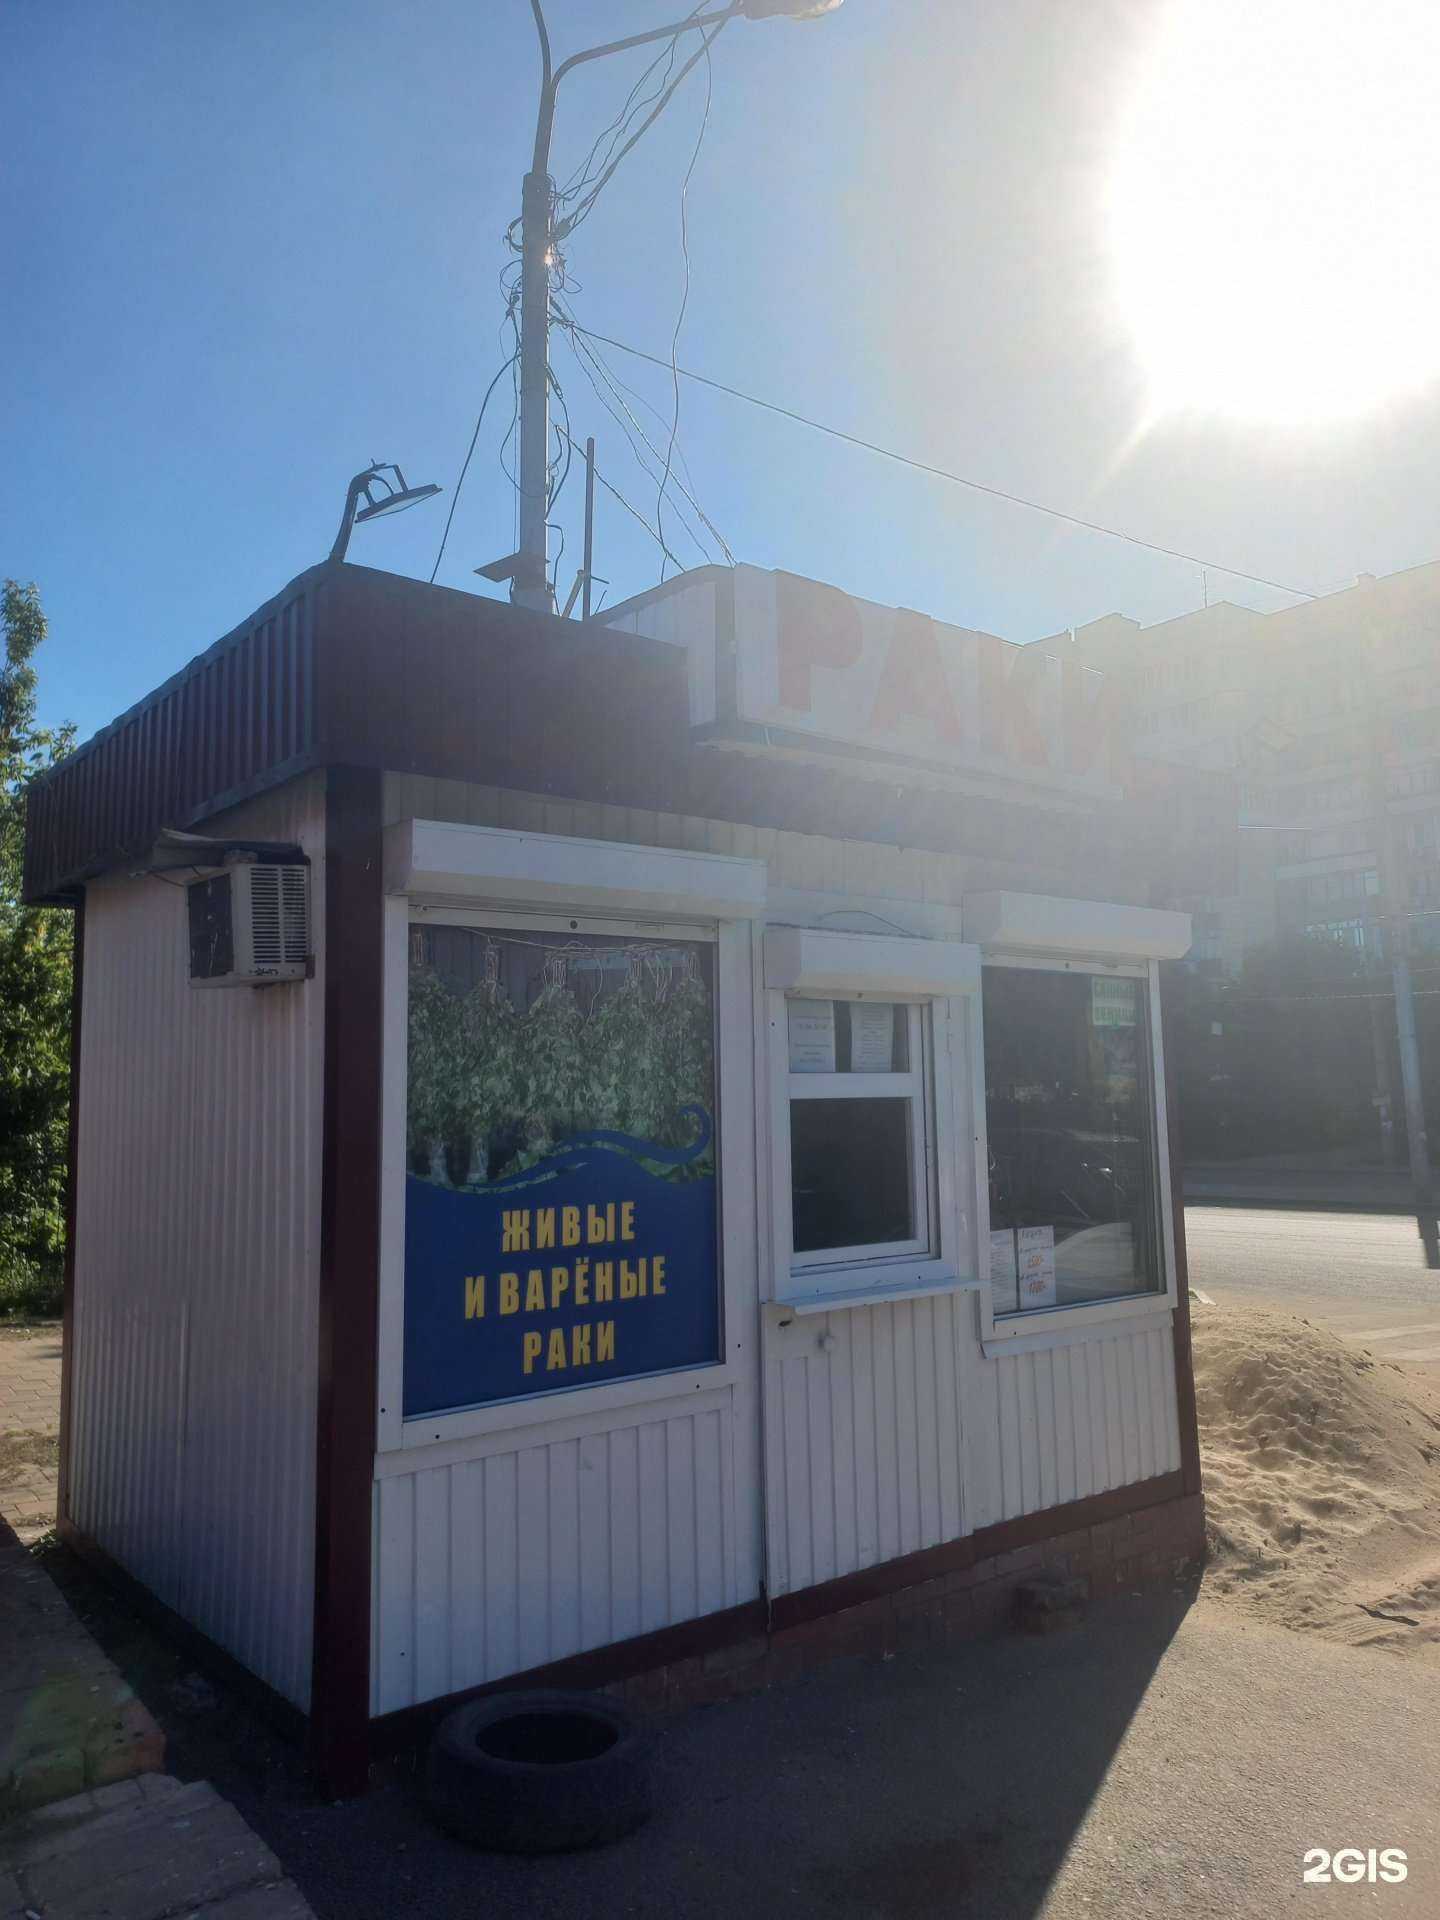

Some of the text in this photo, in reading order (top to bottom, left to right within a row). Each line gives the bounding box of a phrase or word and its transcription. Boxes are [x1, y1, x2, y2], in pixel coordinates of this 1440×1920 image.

[502, 1201, 636, 1253] ЖИВЫЕ
[464, 1256, 667, 1319] И ВАРЁНЫЕ
[522, 1320, 616, 1374] РАКИ
